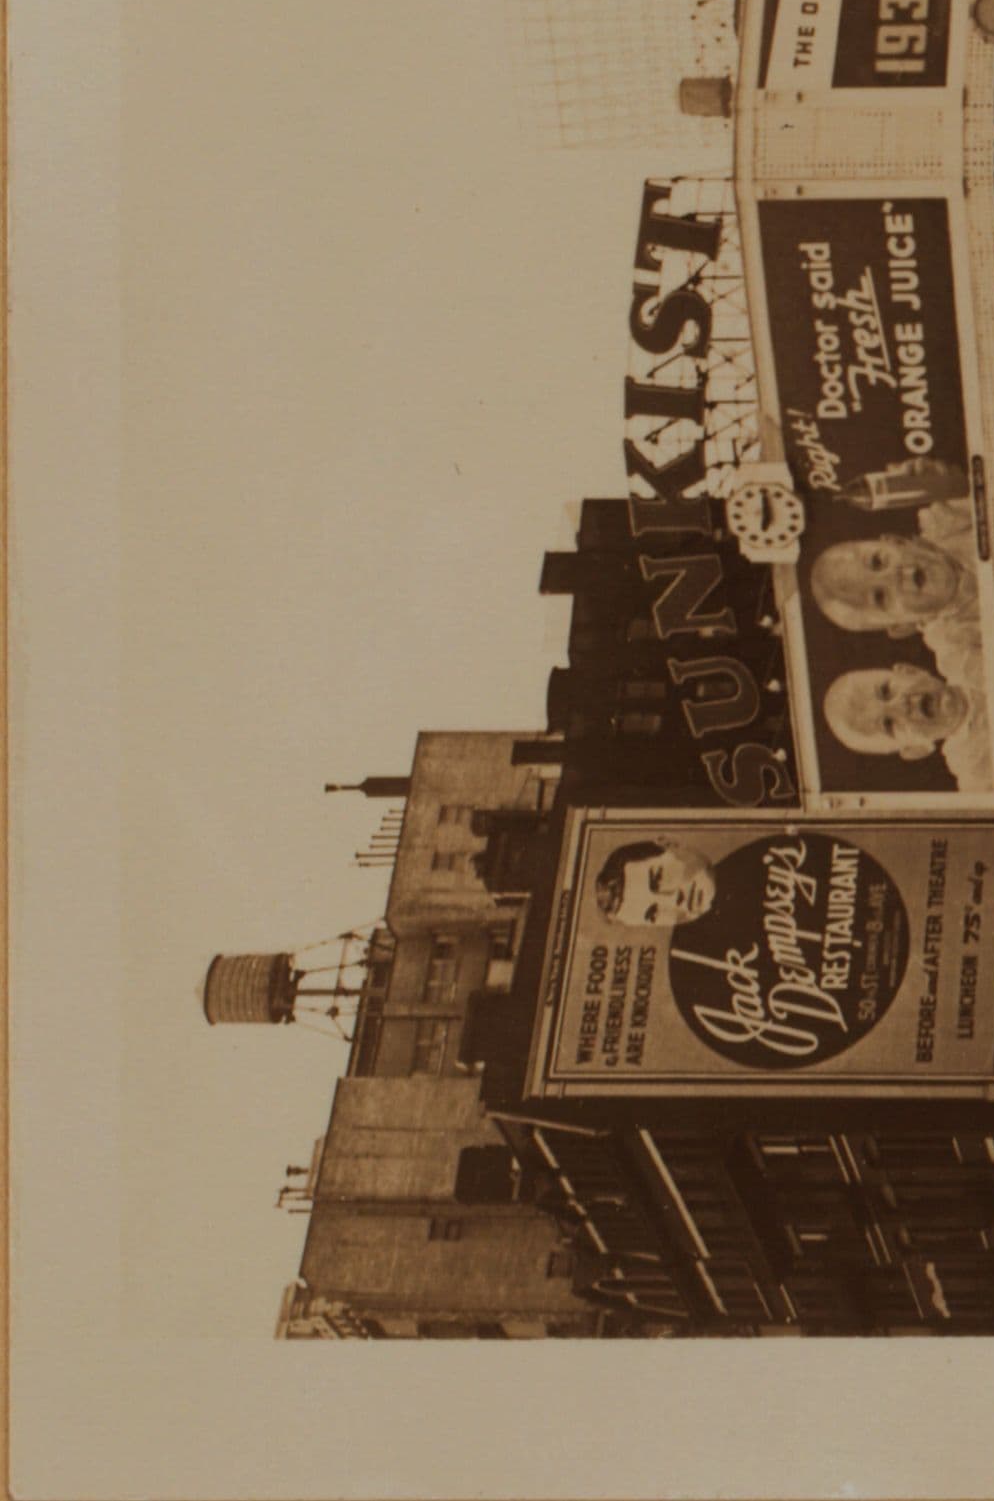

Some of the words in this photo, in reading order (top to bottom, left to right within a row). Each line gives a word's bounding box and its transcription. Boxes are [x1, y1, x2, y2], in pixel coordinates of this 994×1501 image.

[791, 25, 816, 68] THE
[799, 242, 837, 310] said
[813, 318, 847, 419] Doctor
[894, 321, 932, 453] ORANGE
[786, 408, 841, 491] Right!
[623, 181, 796, 806] SUNKIST
[926, 838, 948, 908] THEATRE
[820, 844, 860, 990] RESTAURANT
[922, 915, 943, 967] AFTER
[585, 945, 608, 995] FOOD
[602, 945, 632, 1054] FRIENDLINESS
[629, 945, 656, 1028] KNOCKOUTS
[671, 942, 818, 1055] Jack
[956, 955, 979, 1039] LUNCHEON
[576, 1001, 600, 1064] WHERE
[625, 1031, 645, 1065] ARE
[915, 996, 937, 1063] BEFORE
